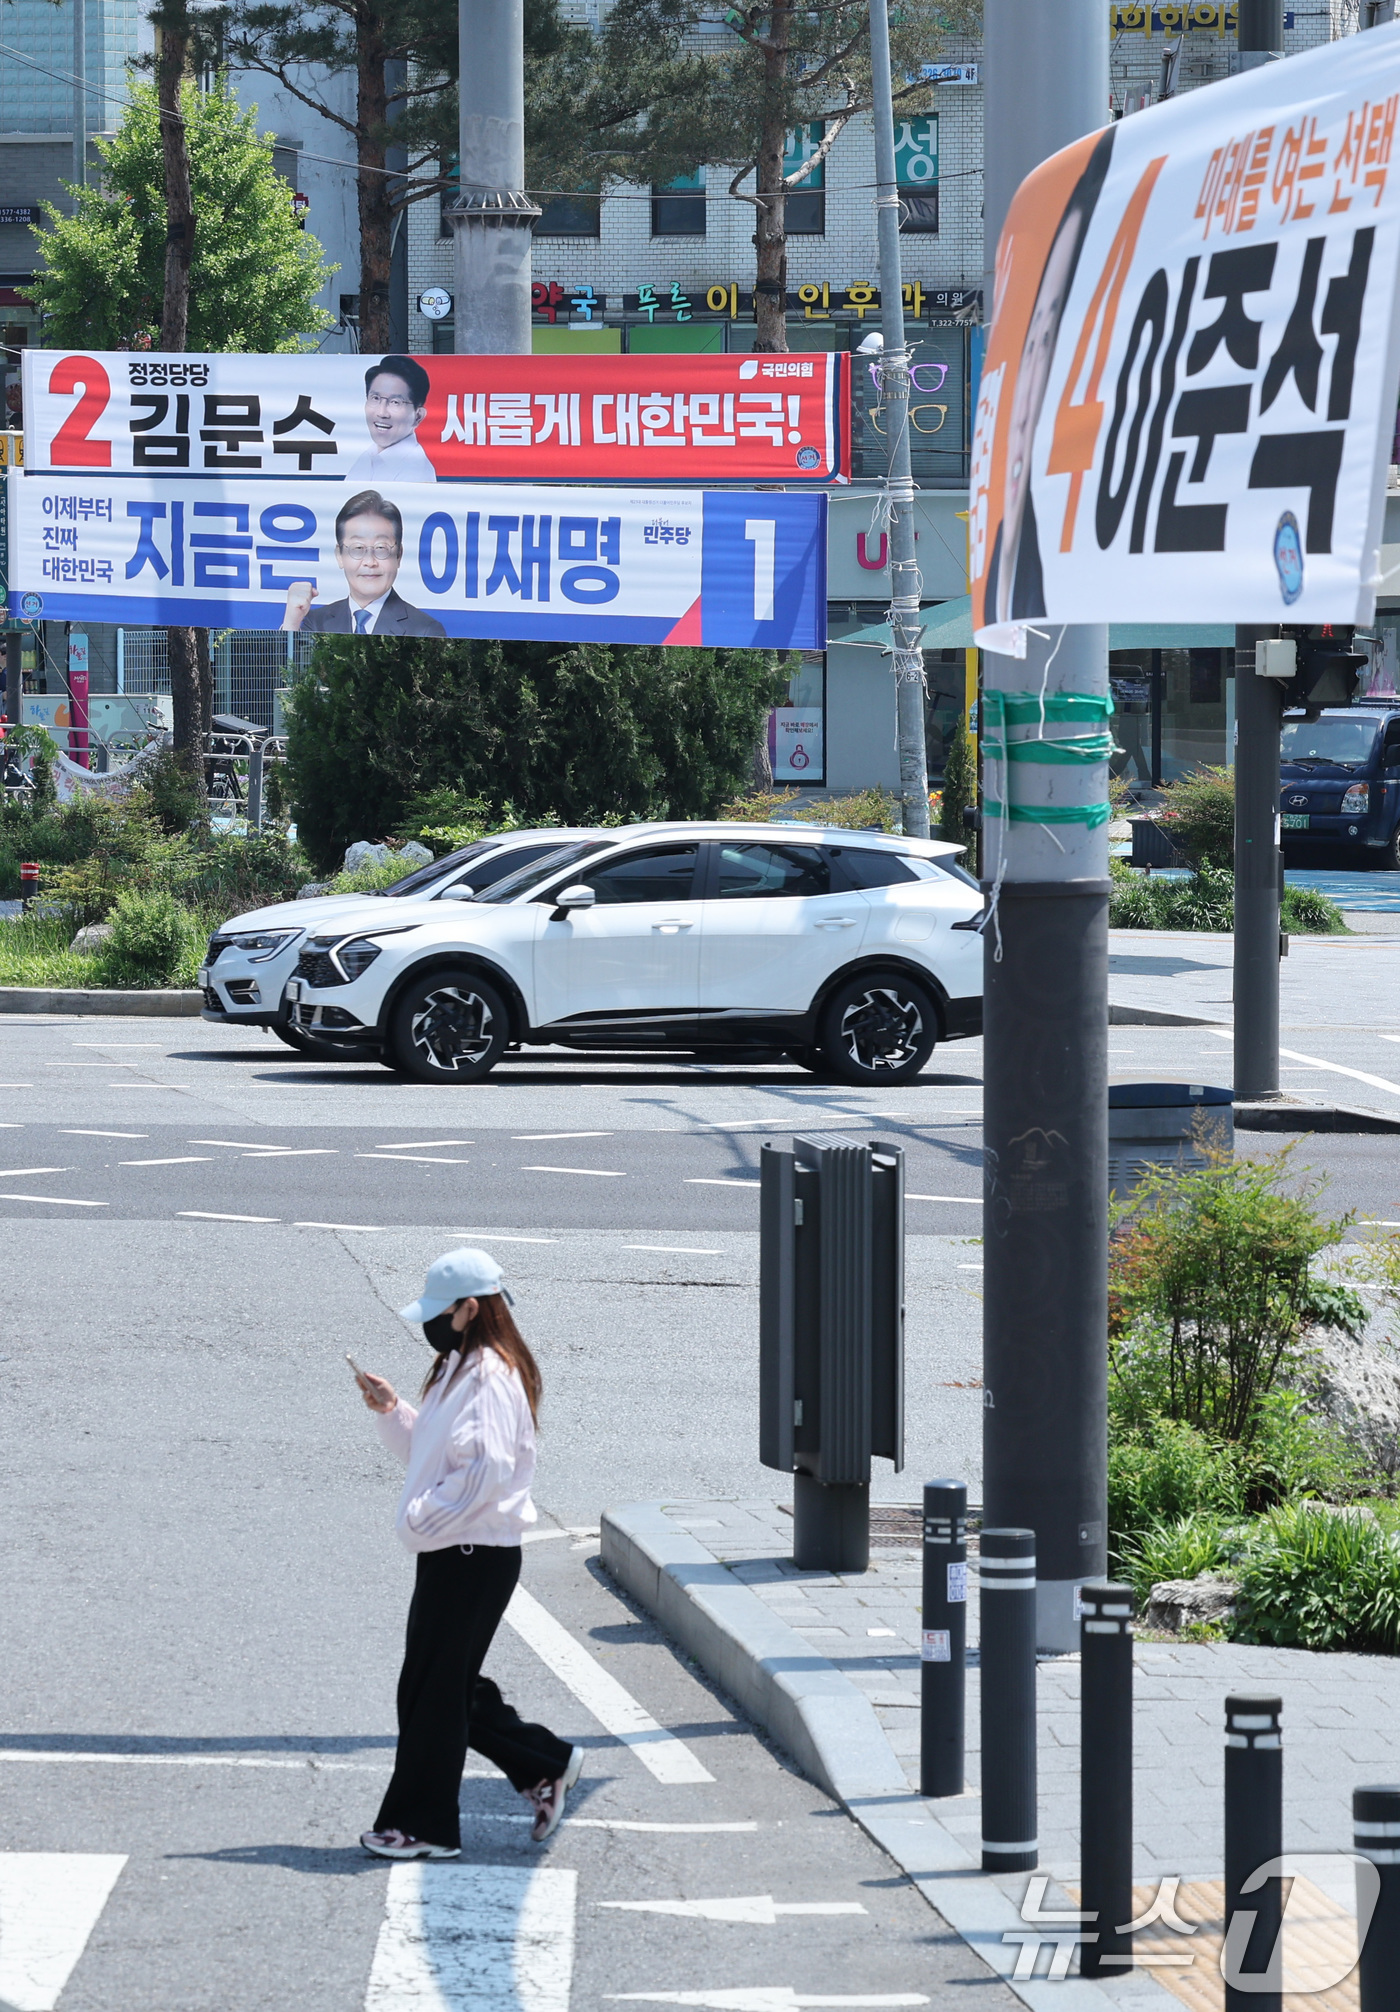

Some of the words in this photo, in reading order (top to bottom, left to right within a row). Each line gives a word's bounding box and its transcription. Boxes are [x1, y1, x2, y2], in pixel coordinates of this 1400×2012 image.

[1194, 125, 1276, 240] 미래를
[1271, 115, 1328, 225] 여는
[1327, 94, 1400, 215] 선택
[706, 279, 926, 319] 이인후과
[128, 362, 210, 387] 정정당당
[761, 362, 813, 378] 국민의힘
[1045, 154, 1169, 553] 4
[48, 355, 112, 468] 2
[440, 392, 581, 447] 새롭게
[591, 392, 802, 447] 대한민국!
[1095, 225, 1377, 555] 이준석
[129, 394, 338, 471] 김문수
[42, 495, 113, 523] 이제부터
[42, 526, 78, 551] 진짜
[643, 526, 692, 546] 민주당
[42, 557, 114, 584] 대한민국
[125, 500, 320, 592] 지금은
[418, 511, 622, 605] 이재명
[744, 519, 776, 621] 1
